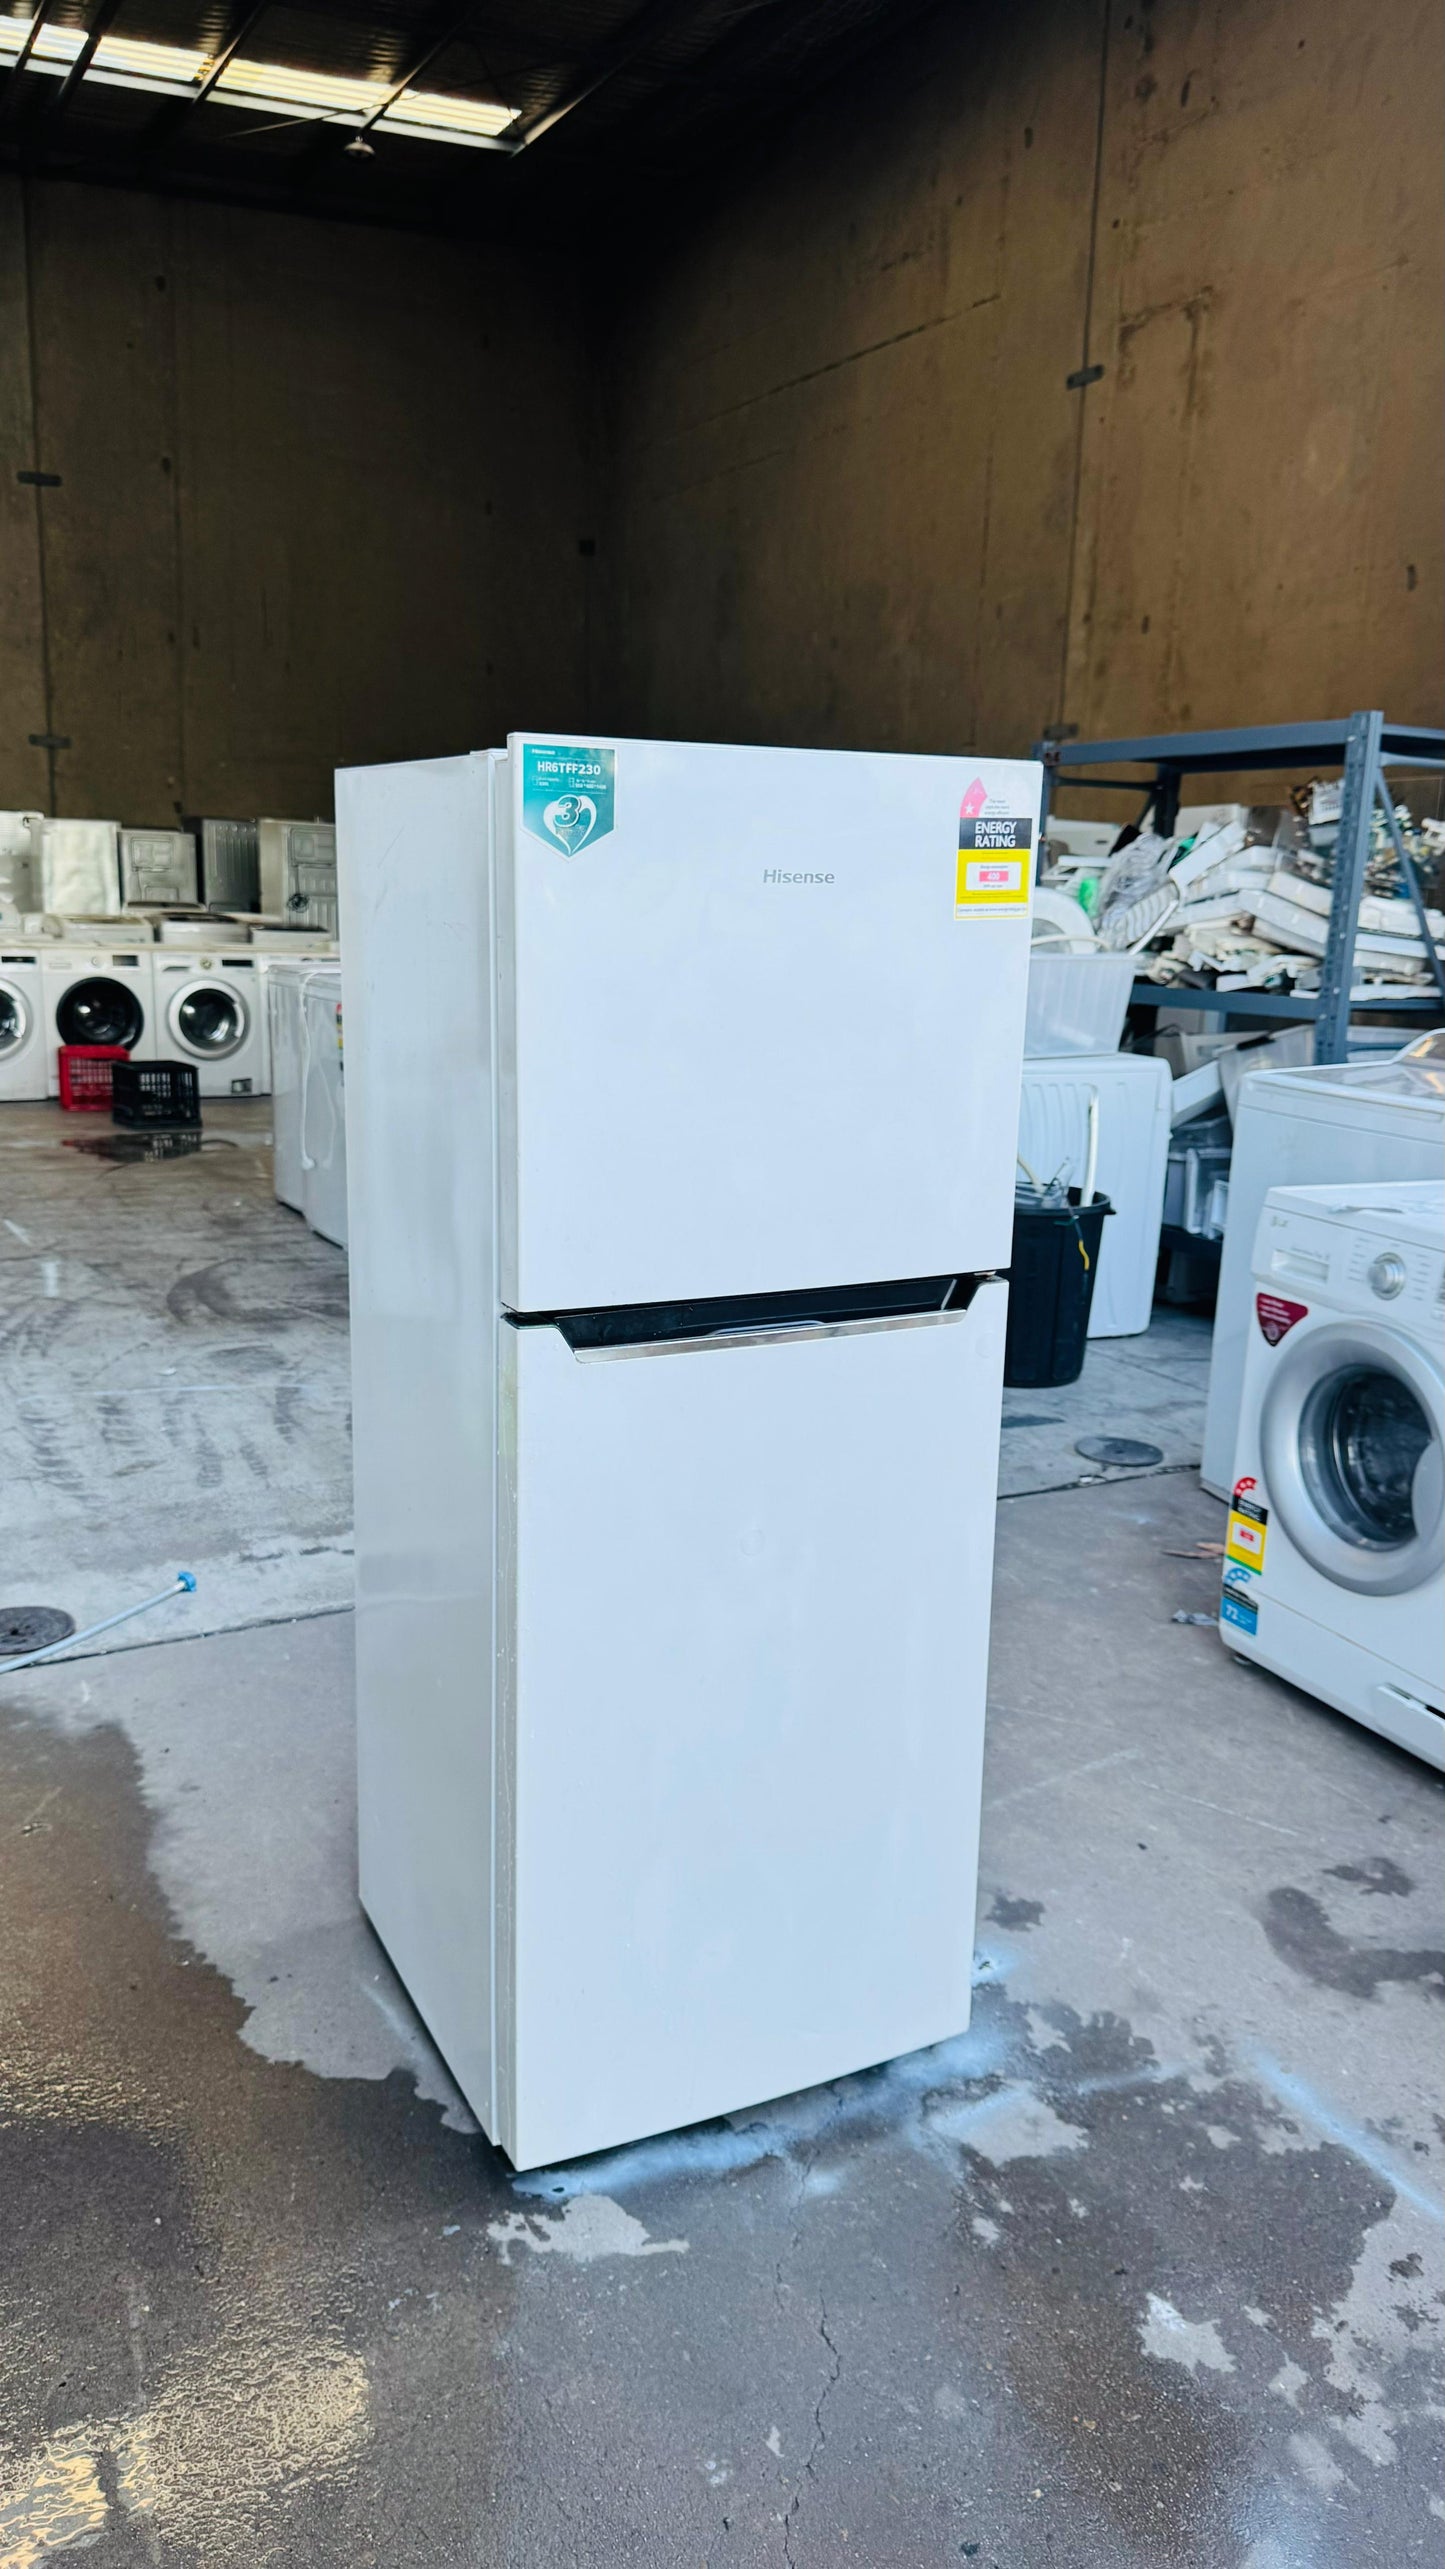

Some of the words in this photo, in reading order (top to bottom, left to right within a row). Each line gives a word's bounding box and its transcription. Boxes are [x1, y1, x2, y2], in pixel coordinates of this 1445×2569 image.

[537, 760, 601, 775] HR6TFF230
[975, 821, 1017, 834] ENERGY
[974, 834, 1016, 848] RATING
[763, 869, 835, 884] Hisense
